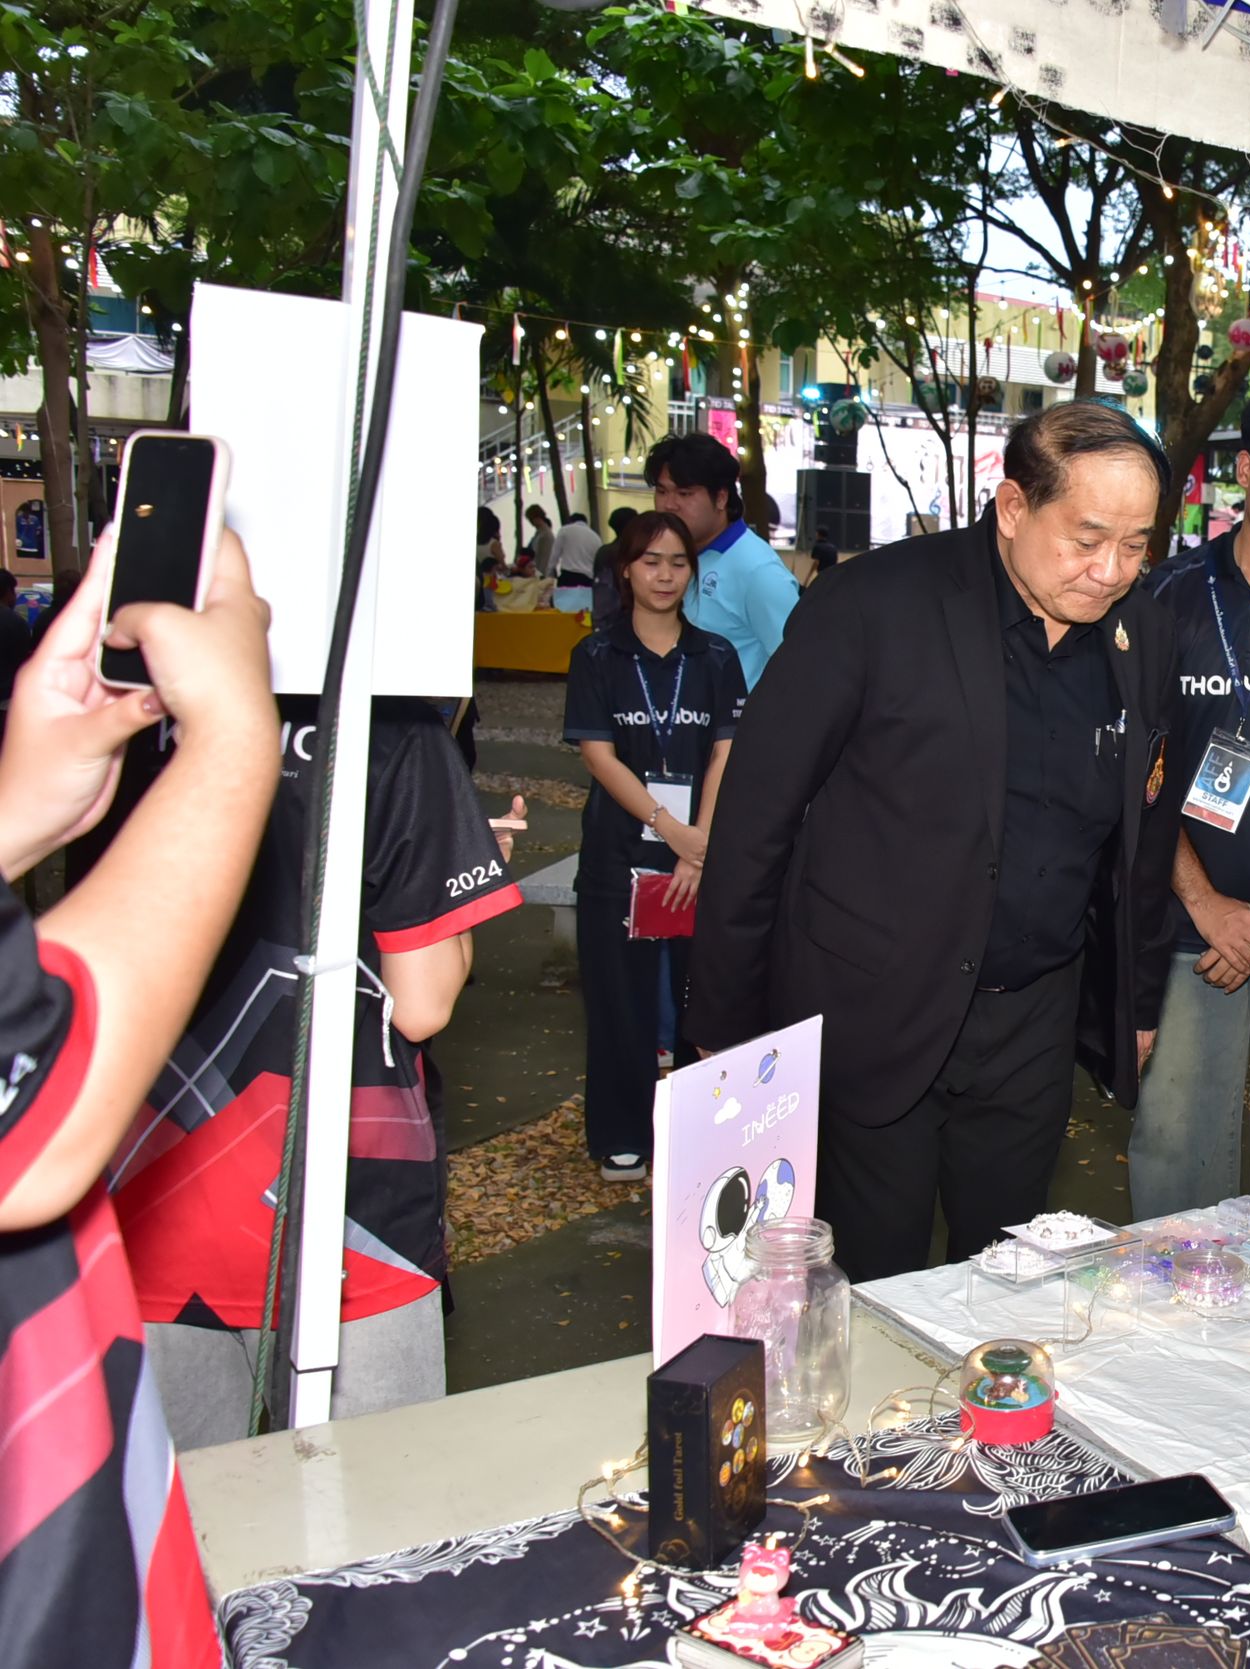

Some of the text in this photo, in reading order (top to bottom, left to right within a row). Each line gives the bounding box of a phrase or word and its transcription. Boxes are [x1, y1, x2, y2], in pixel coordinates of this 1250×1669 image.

[1201, 791, 1230, 808] STAFF
[446, 858, 503, 898] 2024
[673, 1491, 684, 1522] Gold
